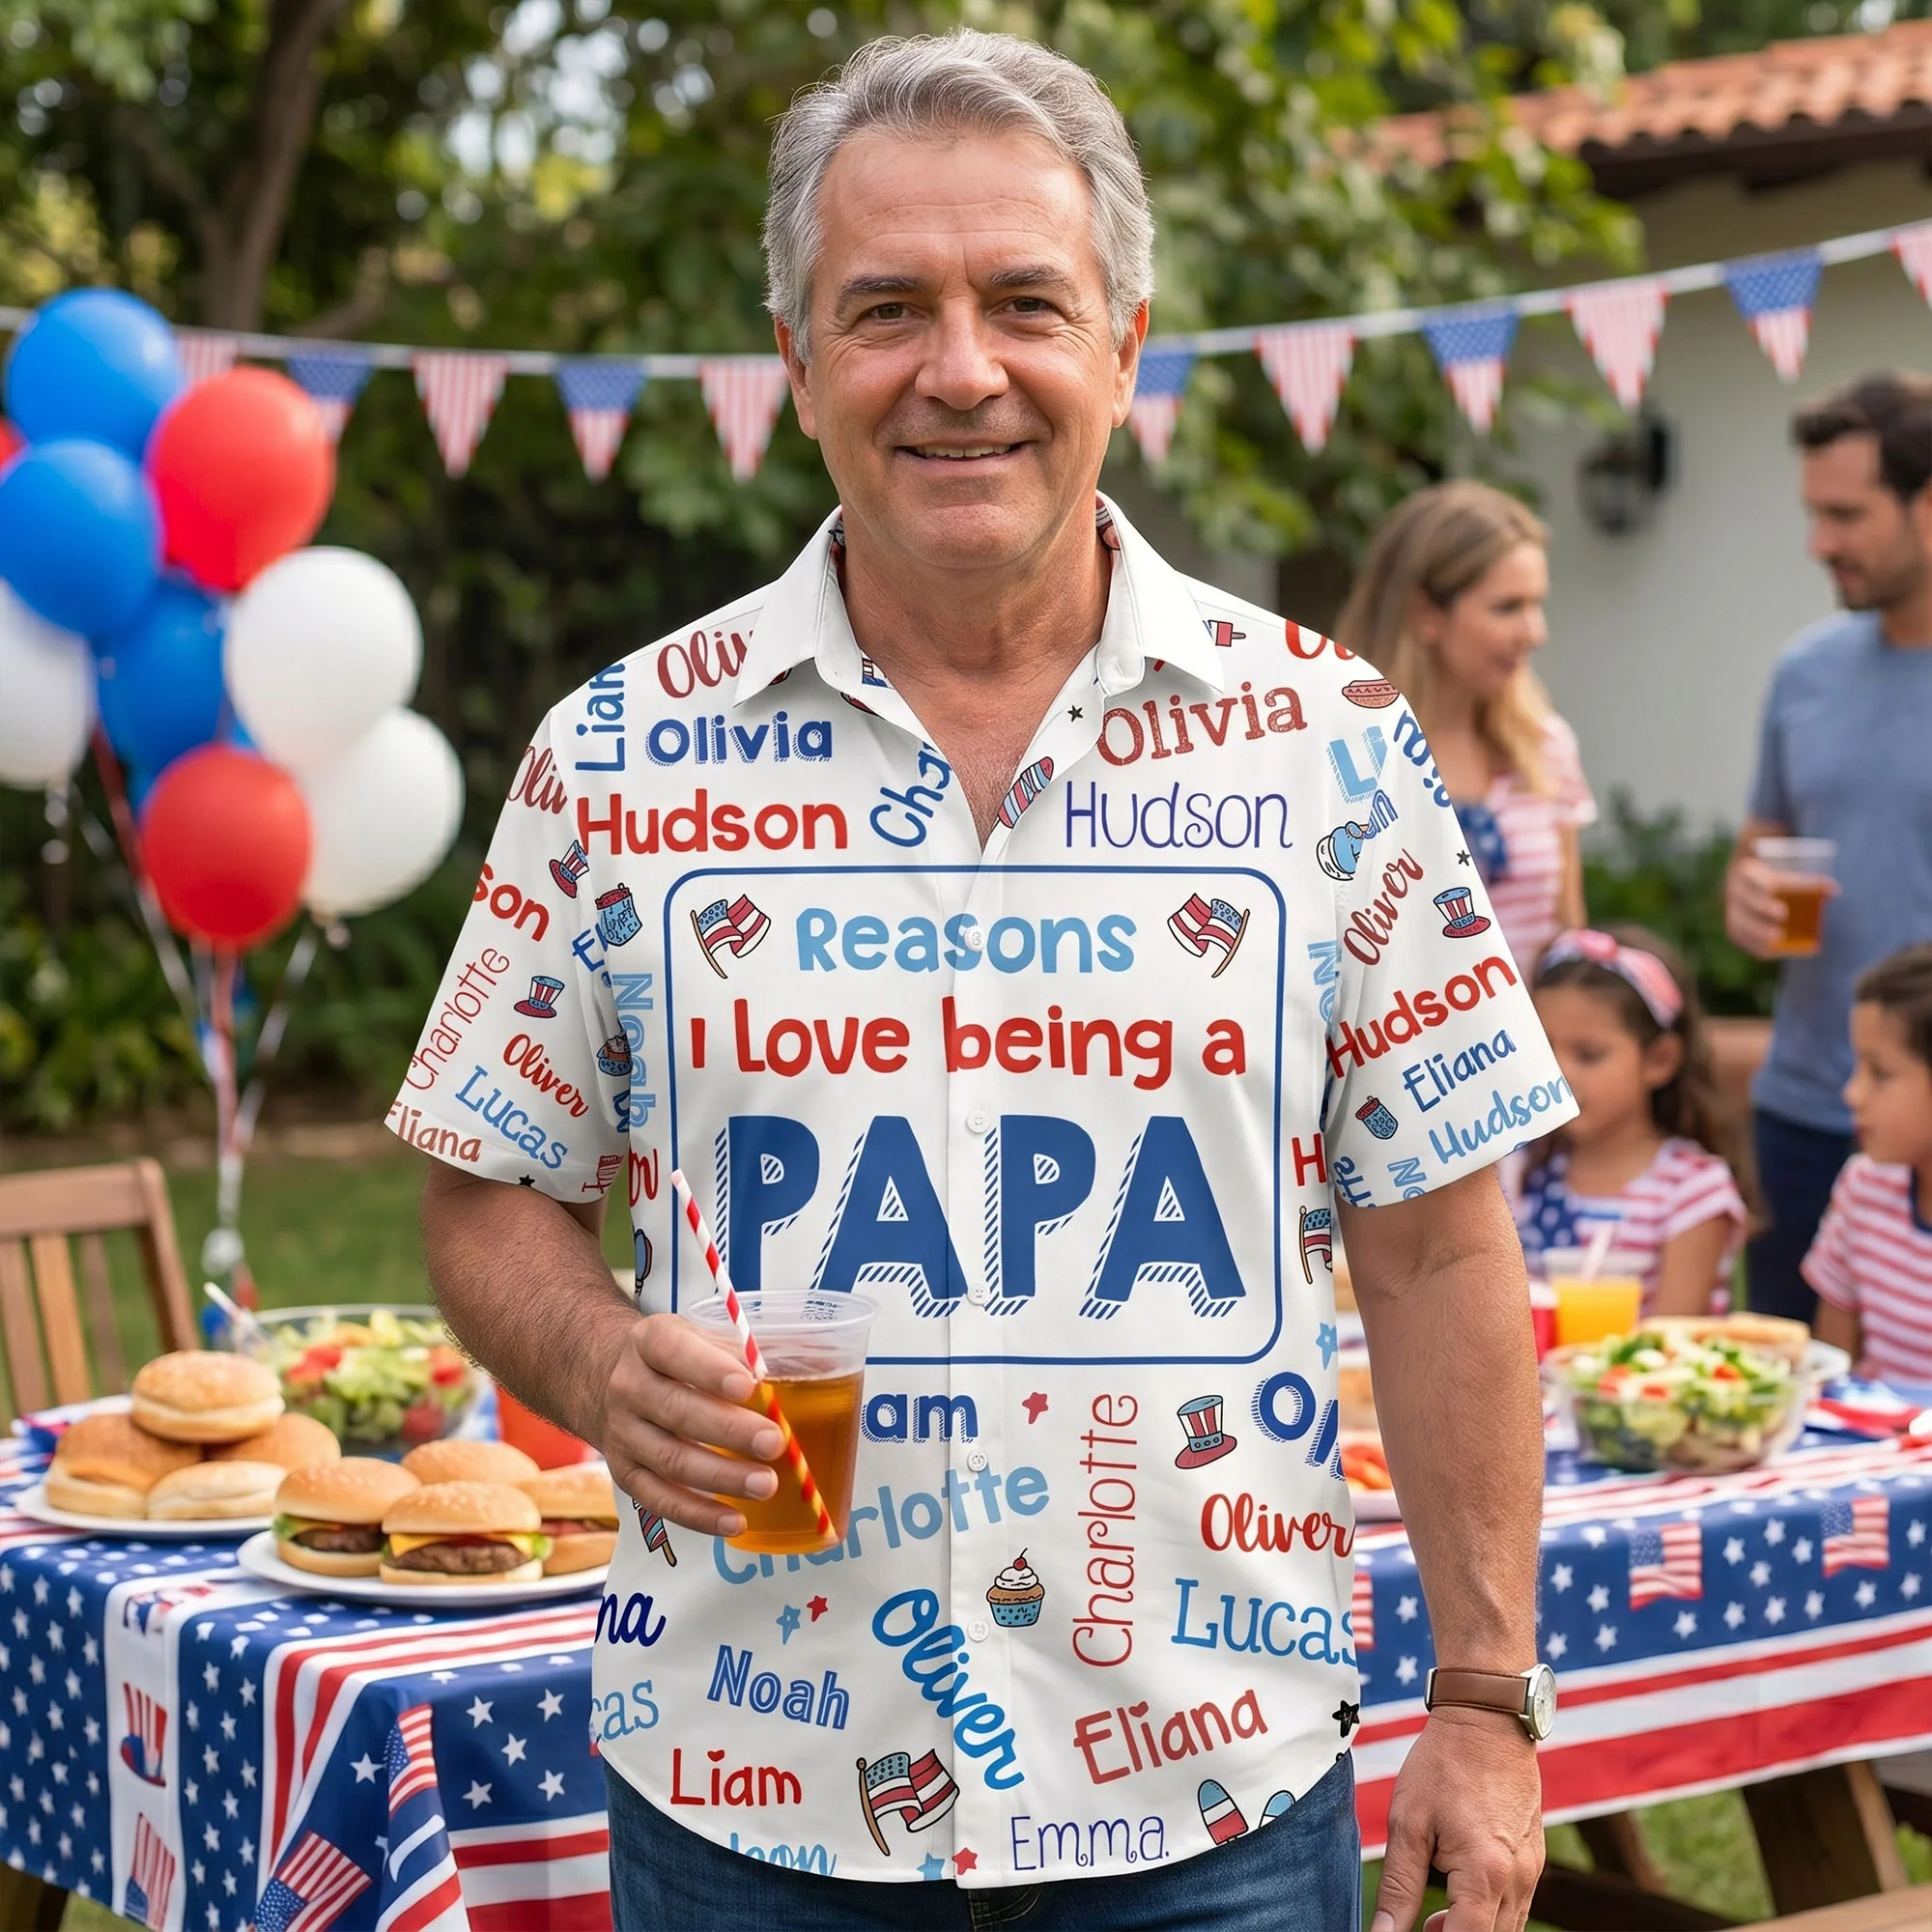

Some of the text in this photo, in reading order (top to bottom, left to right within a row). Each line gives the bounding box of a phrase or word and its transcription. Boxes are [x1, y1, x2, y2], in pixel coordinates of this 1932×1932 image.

[643, 711, 834, 767] Olivia
[1097, 680, 1308, 767] Olivia
[577, 788, 848, 854] Hudson
[1065, 781, 1293, 849] Hudson
[796, 907, 1137, 974] Reasons
[1344, 848, 1424, 966] Oliver
[404, 948, 510, 1091] Charlotte
[691, 996, 1247, 1091] I Love being a
[1325, 956, 1518, 1079] Hudson
[502, 1034, 589, 1118] Oliver
[1404, 1030, 1517, 1113] Eliana
[455, 1065, 568, 1169] Lucas
[1429, 1075, 1574, 1165] Hudson
[714, 1114, 1248, 1321] PAPA
[1072, 1394, 1139, 1668] Charlotte
[1201, 1492, 1355, 1558] Oliver
[707, 1644, 851, 1730] Noah
[871, 1588, 1026, 1791] Oliver
[669, 1747, 803, 1806] Liam
[1073, 1690, 1268, 1785] Eliana
